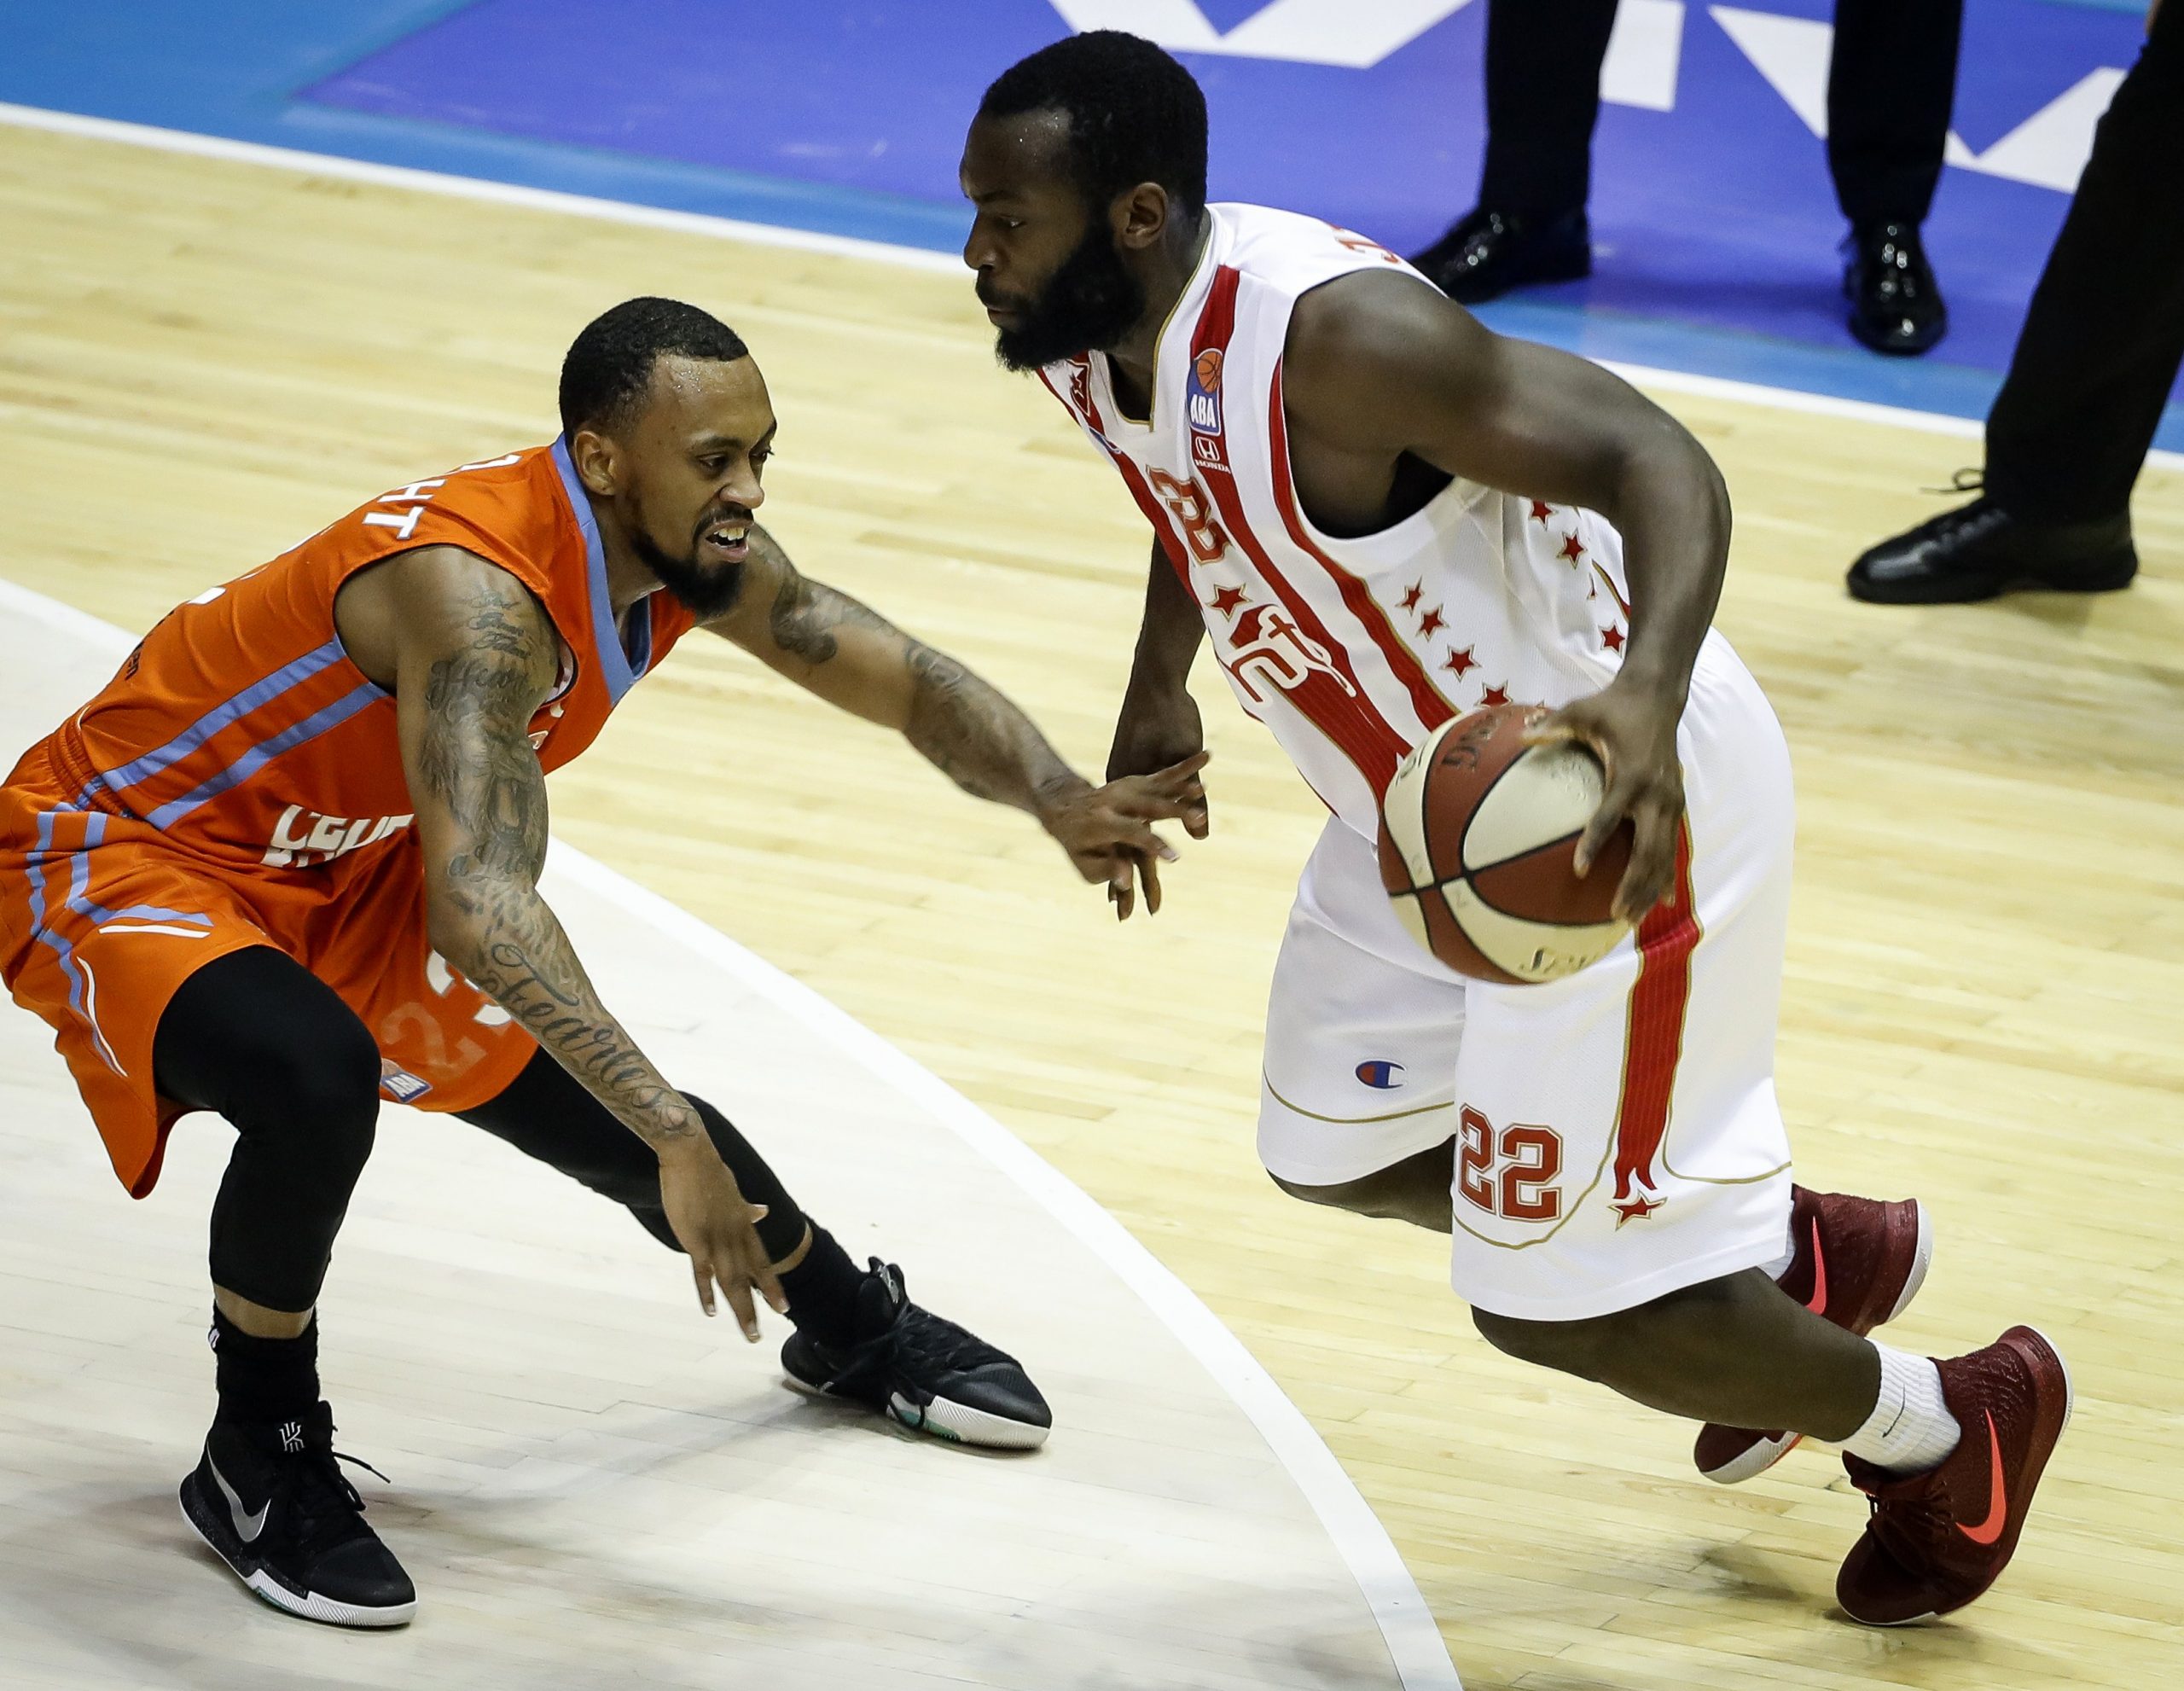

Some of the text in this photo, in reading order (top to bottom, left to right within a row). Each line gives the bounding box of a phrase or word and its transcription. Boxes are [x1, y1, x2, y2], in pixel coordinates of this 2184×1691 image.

[1190, 393, 1217, 428] ABA
[1194, 459, 1231, 474] HONDA
[1456, 1102, 1564, 1223] 22
